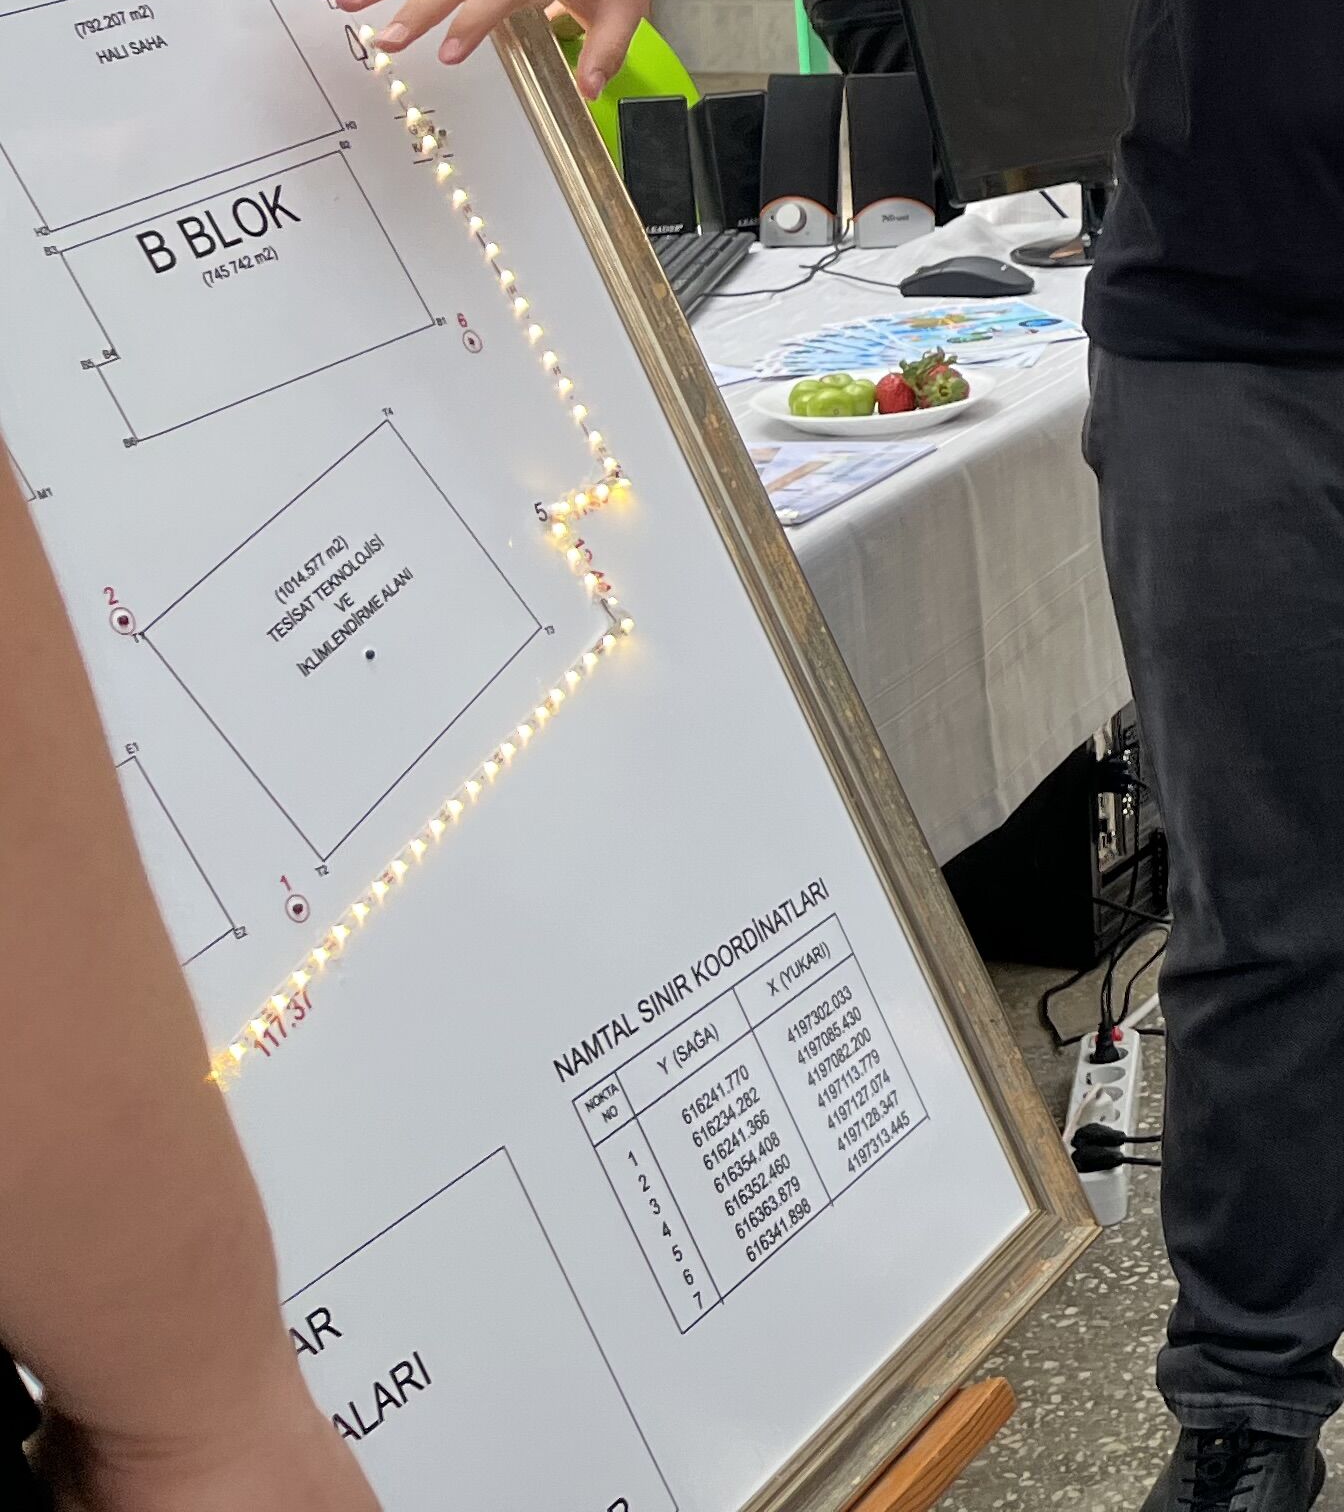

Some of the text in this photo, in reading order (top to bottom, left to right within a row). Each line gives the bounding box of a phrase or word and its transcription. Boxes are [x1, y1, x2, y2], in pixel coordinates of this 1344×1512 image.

[129, 35, 168, 55] SAHA
[136, 185, 301, 274] B BLOK
[456, 313, 468, 328] 6
[534, 502, 548, 522] 5
[103, 586, 118, 606] 2
[333, 592, 355, 613] VE
[381, 567, 414, 602] ALANI
[125, 741, 140, 755] E1
[279, 875, 292, 891] 1
[552, 877, 830, 1083] NAMTAL SINIR KOORDİNATLARI
[766, 941, 832, 996] X (YUKARI)
[657, 1023, 720, 1075] Y (SAĞA)
[584, 1083, 620, 1113] NOKTA
[601, 1105, 619, 1124] NO
[627, 1151, 638, 1167] 1
[681, 1064, 750, 1124] 616241.770
[638, 1174, 650, 1192] 2
[692, 1087, 760, 1147] 616234.282
[649, 1198, 661, 1215] 3
[703, 1109, 770, 1170] 616241.366
[662, 1221, 671, 1238] 4
[713, 1131, 781, 1193] 616354.408
[672, 1245, 683, 1262] 5
[724, 1153, 791, 1216] 616352.460
[682, 1269, 694, 1286] 6
[735, 1176, 801, 1239] 616363.879
[692, 1292, 703, 1310] 7
[745, 1198, 812, 1262] 616341.898
[288, 1306, 343, 1356] AR
[331, 1350, 432, 1441] ALARI
